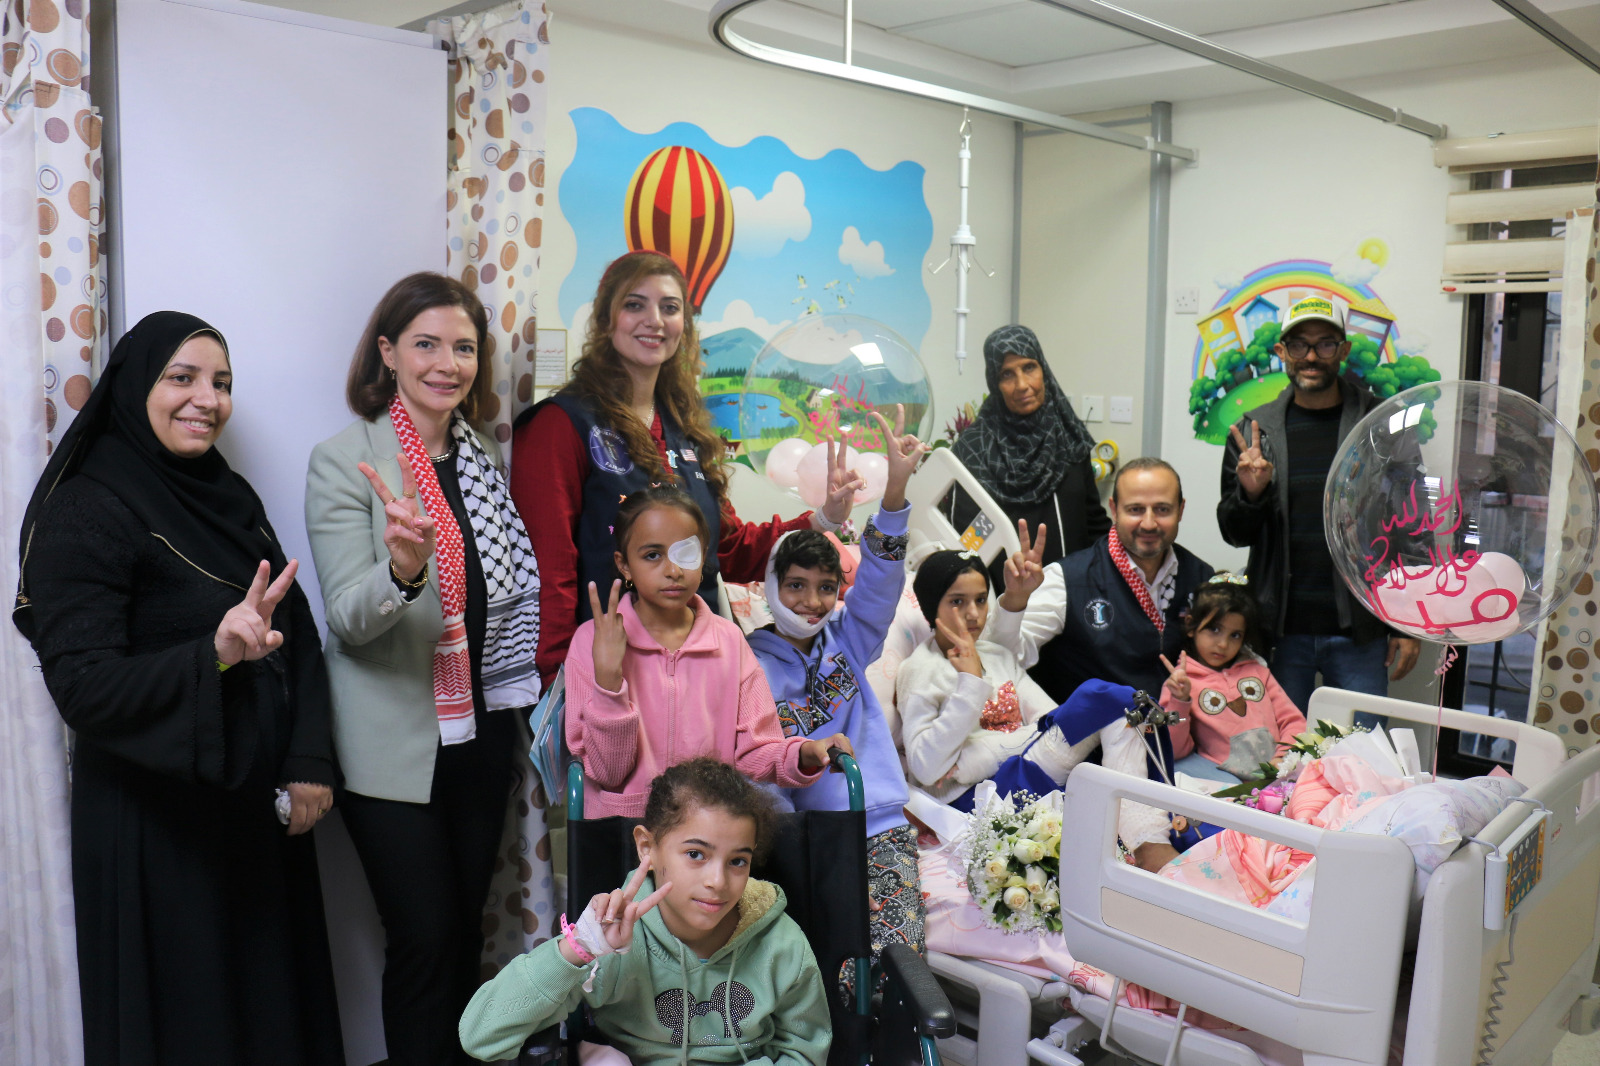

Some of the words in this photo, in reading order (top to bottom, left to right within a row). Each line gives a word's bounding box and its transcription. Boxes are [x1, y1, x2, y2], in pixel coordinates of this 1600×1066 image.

[1382, 479, 1418, 532] لله
[1408, 476, 1463, 536] الحمد
[1364, 536, 1448, 595] السلامة
